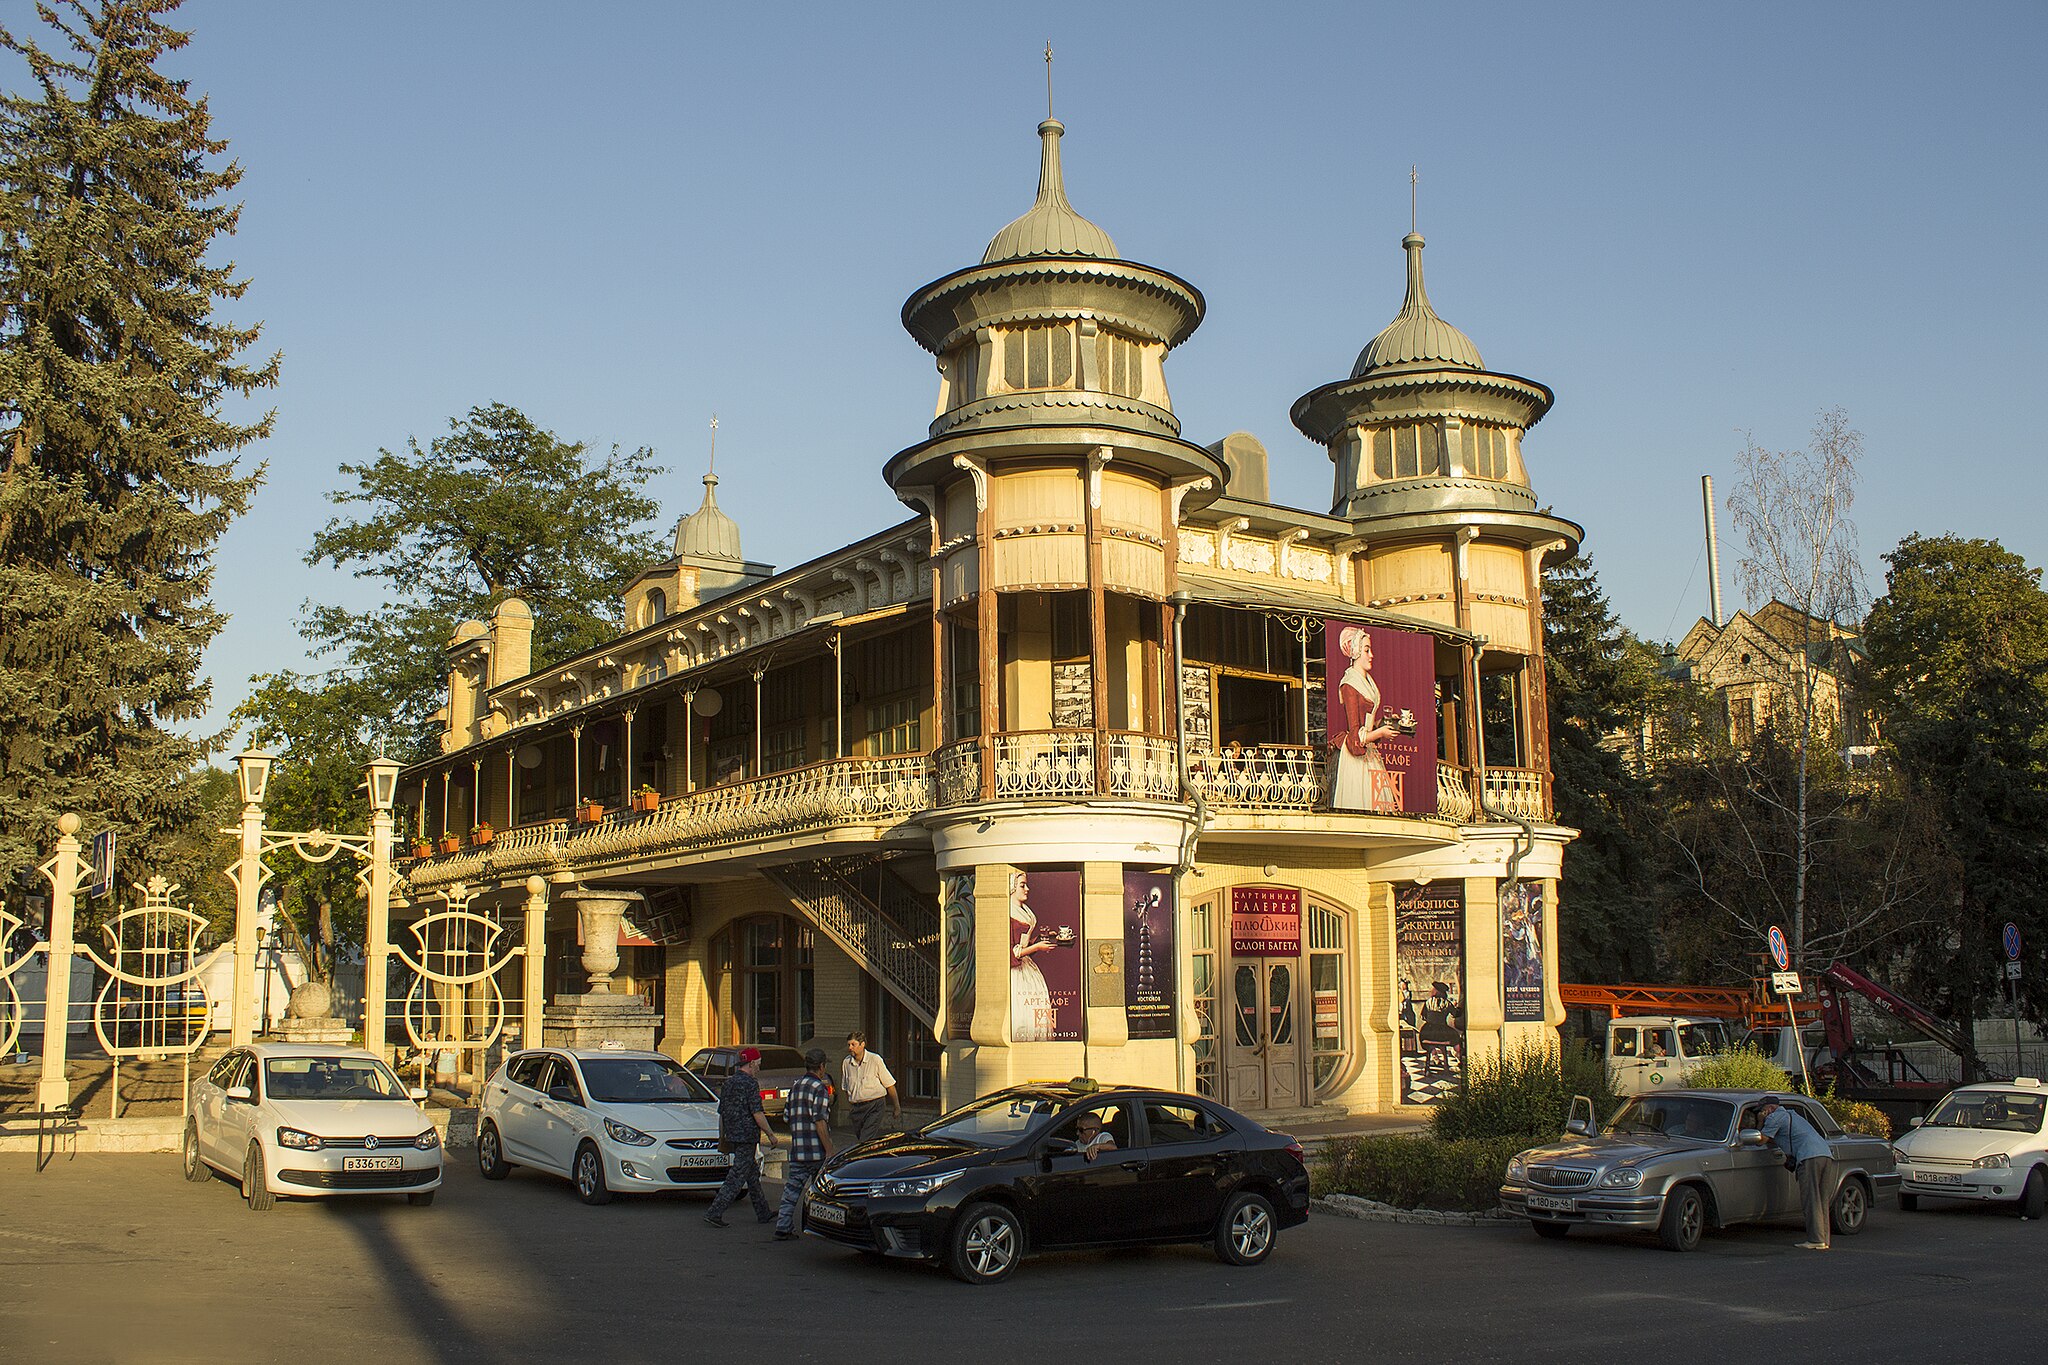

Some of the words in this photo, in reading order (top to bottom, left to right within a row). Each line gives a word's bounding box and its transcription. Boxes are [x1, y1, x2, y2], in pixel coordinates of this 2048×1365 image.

[1233, 891, 1297, 901] КАРТИННАЯ
[1234, 901, 1297, 913] ГАЛЕРЕЯ
[1396, 899, 1460, 910] ЖИВОПИСЬ
[1234, 915, 1297, 932] ПЛЮШКИН
[1403, 920, 1456, 931] АКВАРЕЛИ
[1404, 931, 1455, 942] ПАСТЕЛИ
[1234, 940, 1266, 951] САЛОН
[1268, 941, 1298, 951] БАГЕТА
[1404, 947, 1453, 957] ОТКРЫТКИ
[1023, 997, 1070, 1007] АРТ-КАФЕ
[347, 1158, 387, 1169] В336ТС
[388, 1157, 399, 1166] 26
[683, 1157, 715, 1167] А946КР
